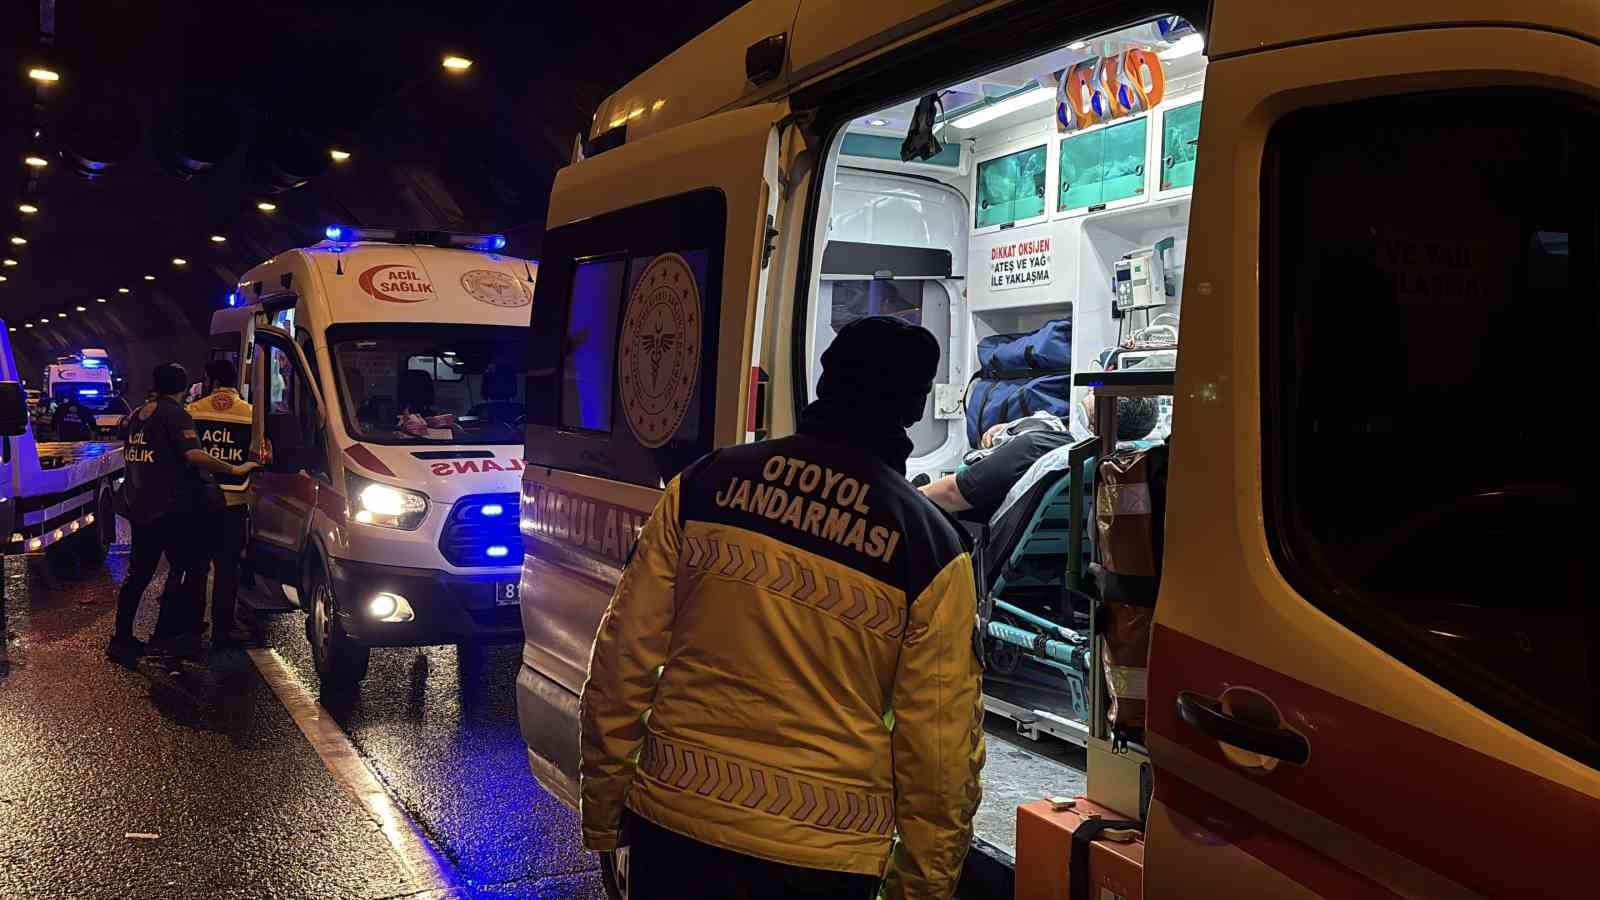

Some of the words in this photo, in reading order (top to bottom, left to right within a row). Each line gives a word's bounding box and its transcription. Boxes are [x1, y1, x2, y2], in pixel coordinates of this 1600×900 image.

[994, 260, 1014, 273] ATEŞ
[1016, 258, 1027, 270] VE
[1029, 253, 1046, 268] YAĞ
[388, 269, 420, 281] ACİL
[991, 274, 1003, 287] İLE
[1005, 270, 1049, 284] YAKLAŞMA
[381, 281, 433, 293] SAĞLIK
[202, 427, 235, 444] ACİL
[125, 446, 155, 463] ĞLIK
[203, 444, 242, 461] ĞLIK
[762, 455, 871, 515] OTOYOL
[715, 477, 901, 563] JANDARMASI
